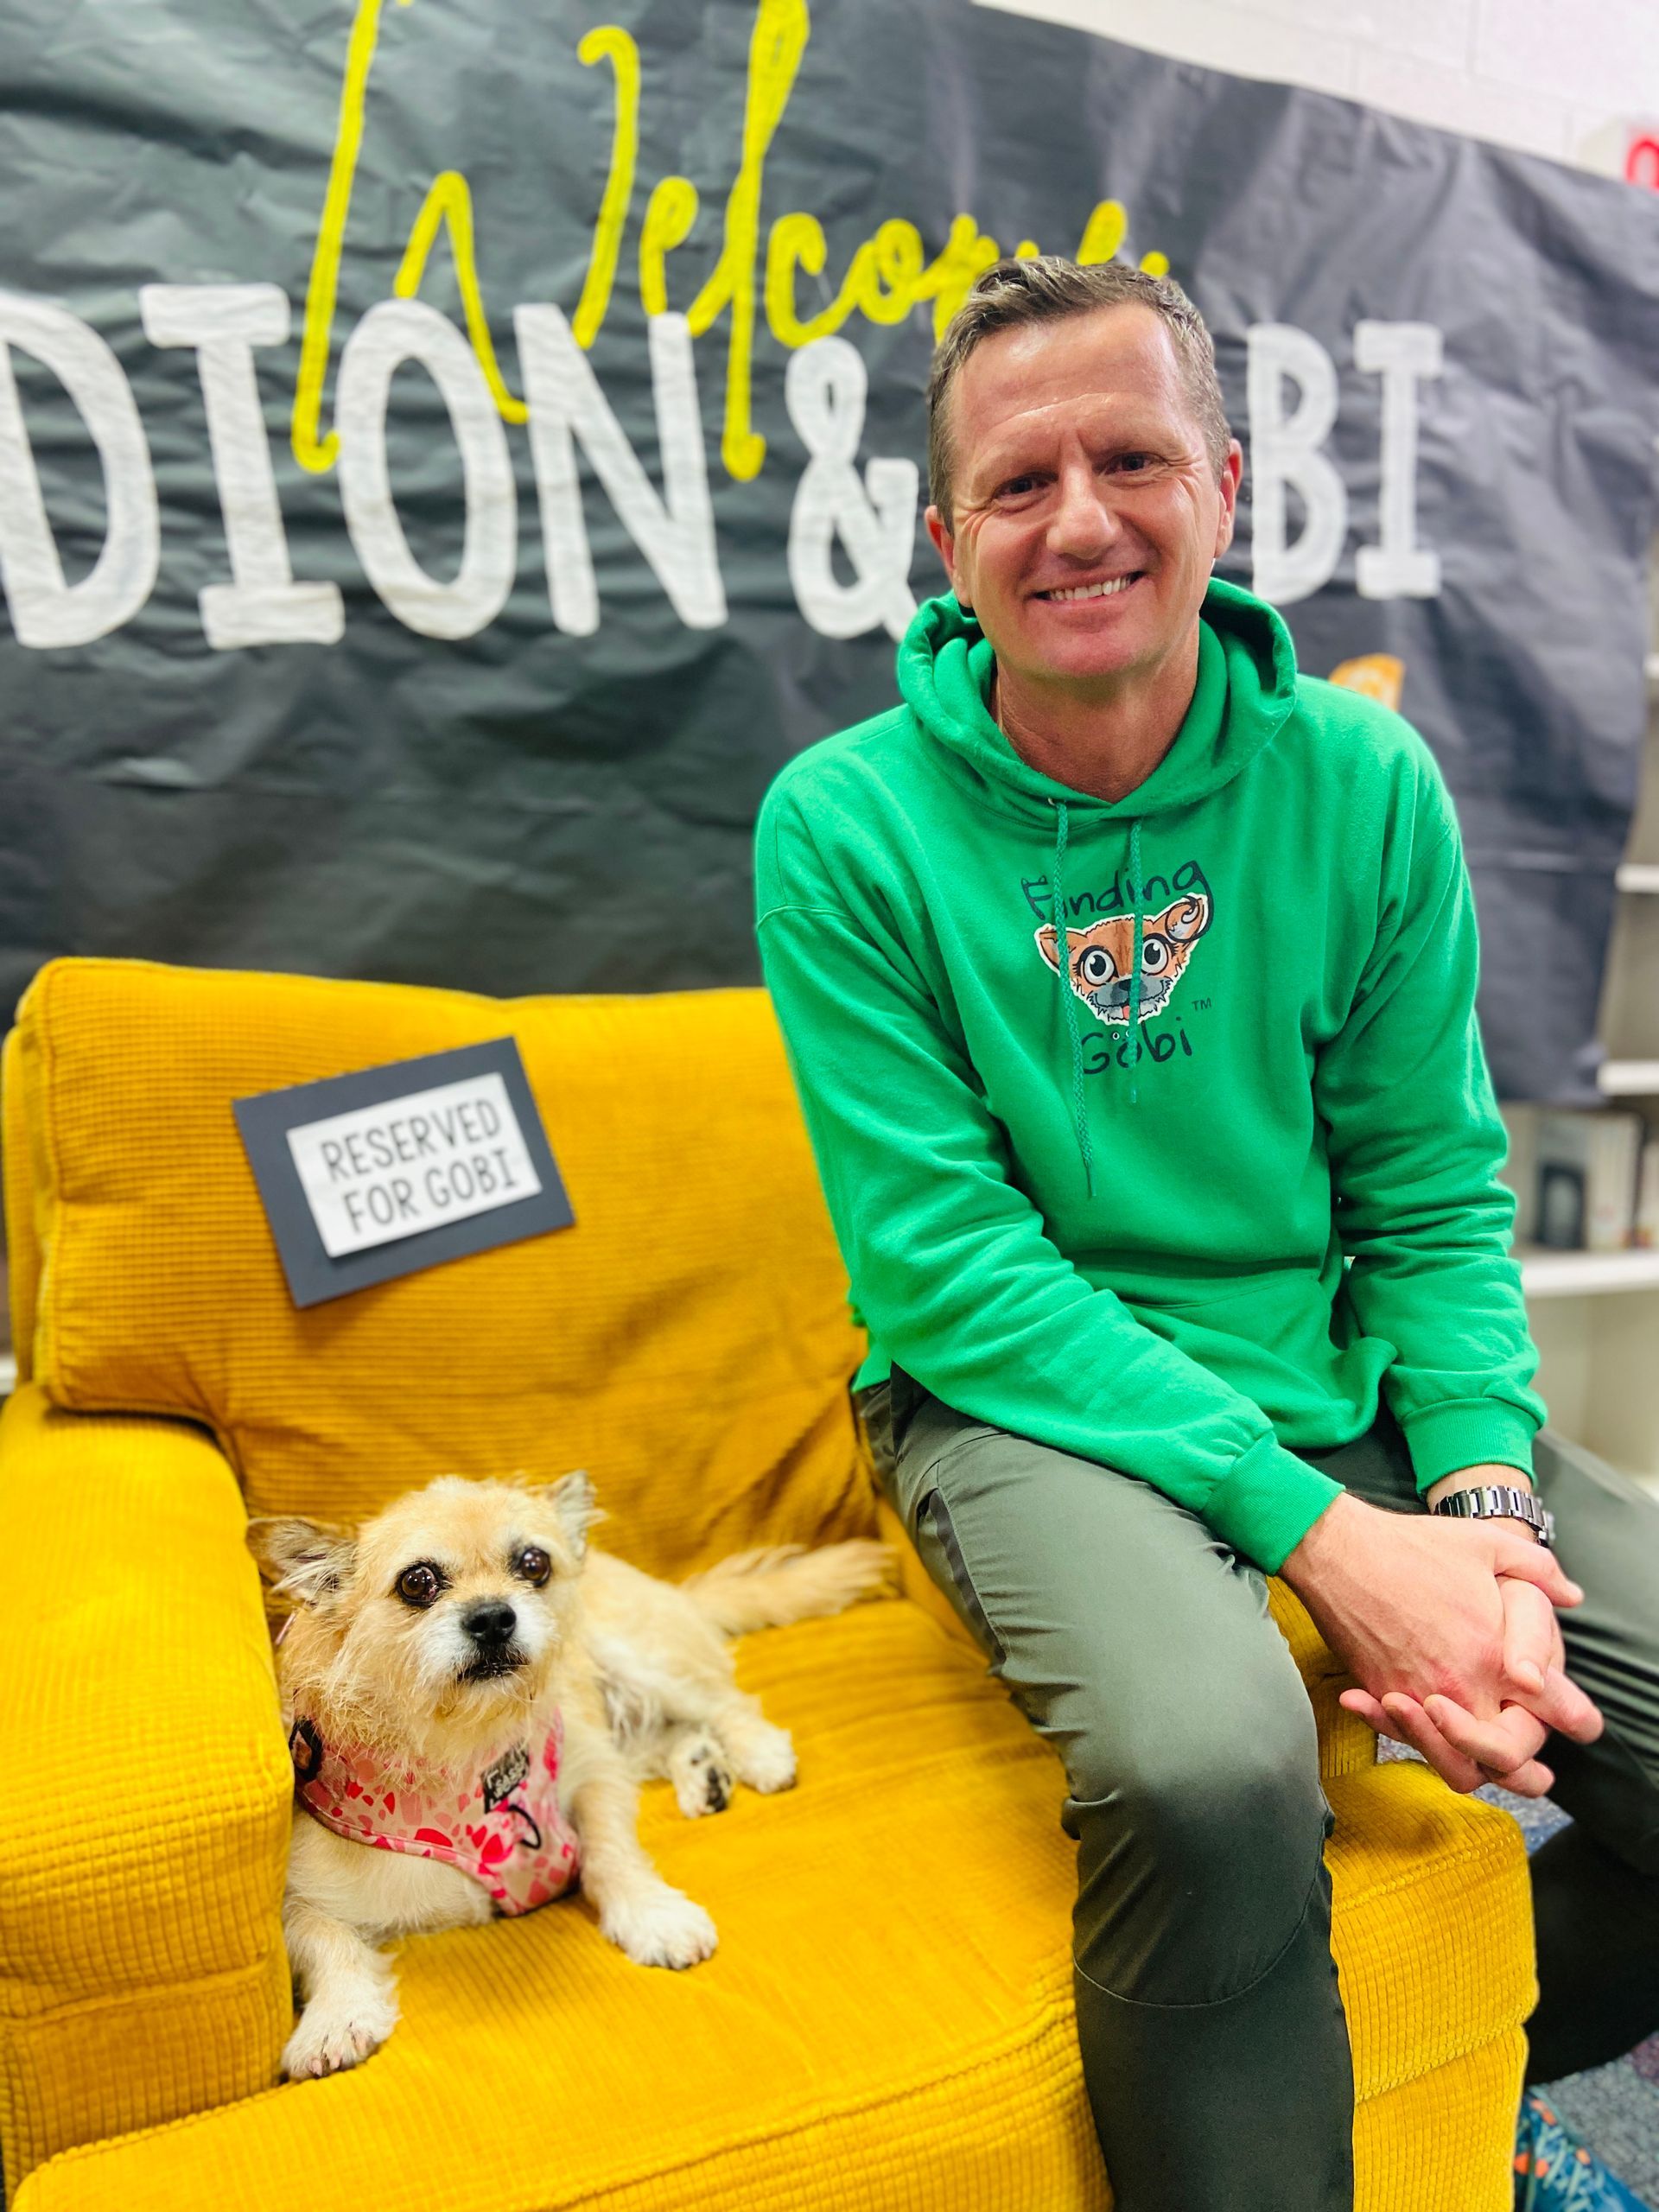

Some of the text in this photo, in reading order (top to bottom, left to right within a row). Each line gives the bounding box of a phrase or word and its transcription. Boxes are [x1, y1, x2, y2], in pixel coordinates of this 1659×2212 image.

[292, 0, 1170, 480] Welco
[0, 283, 1443, 649] DION & BI
[1020, 860, 1214, 943] Fnding
[1081, 1016, 1192, 1075] Gobi
[321, 1098, 501, 1183] RESERVED
[343, 1147, 521, 1234] FOR GOBI
